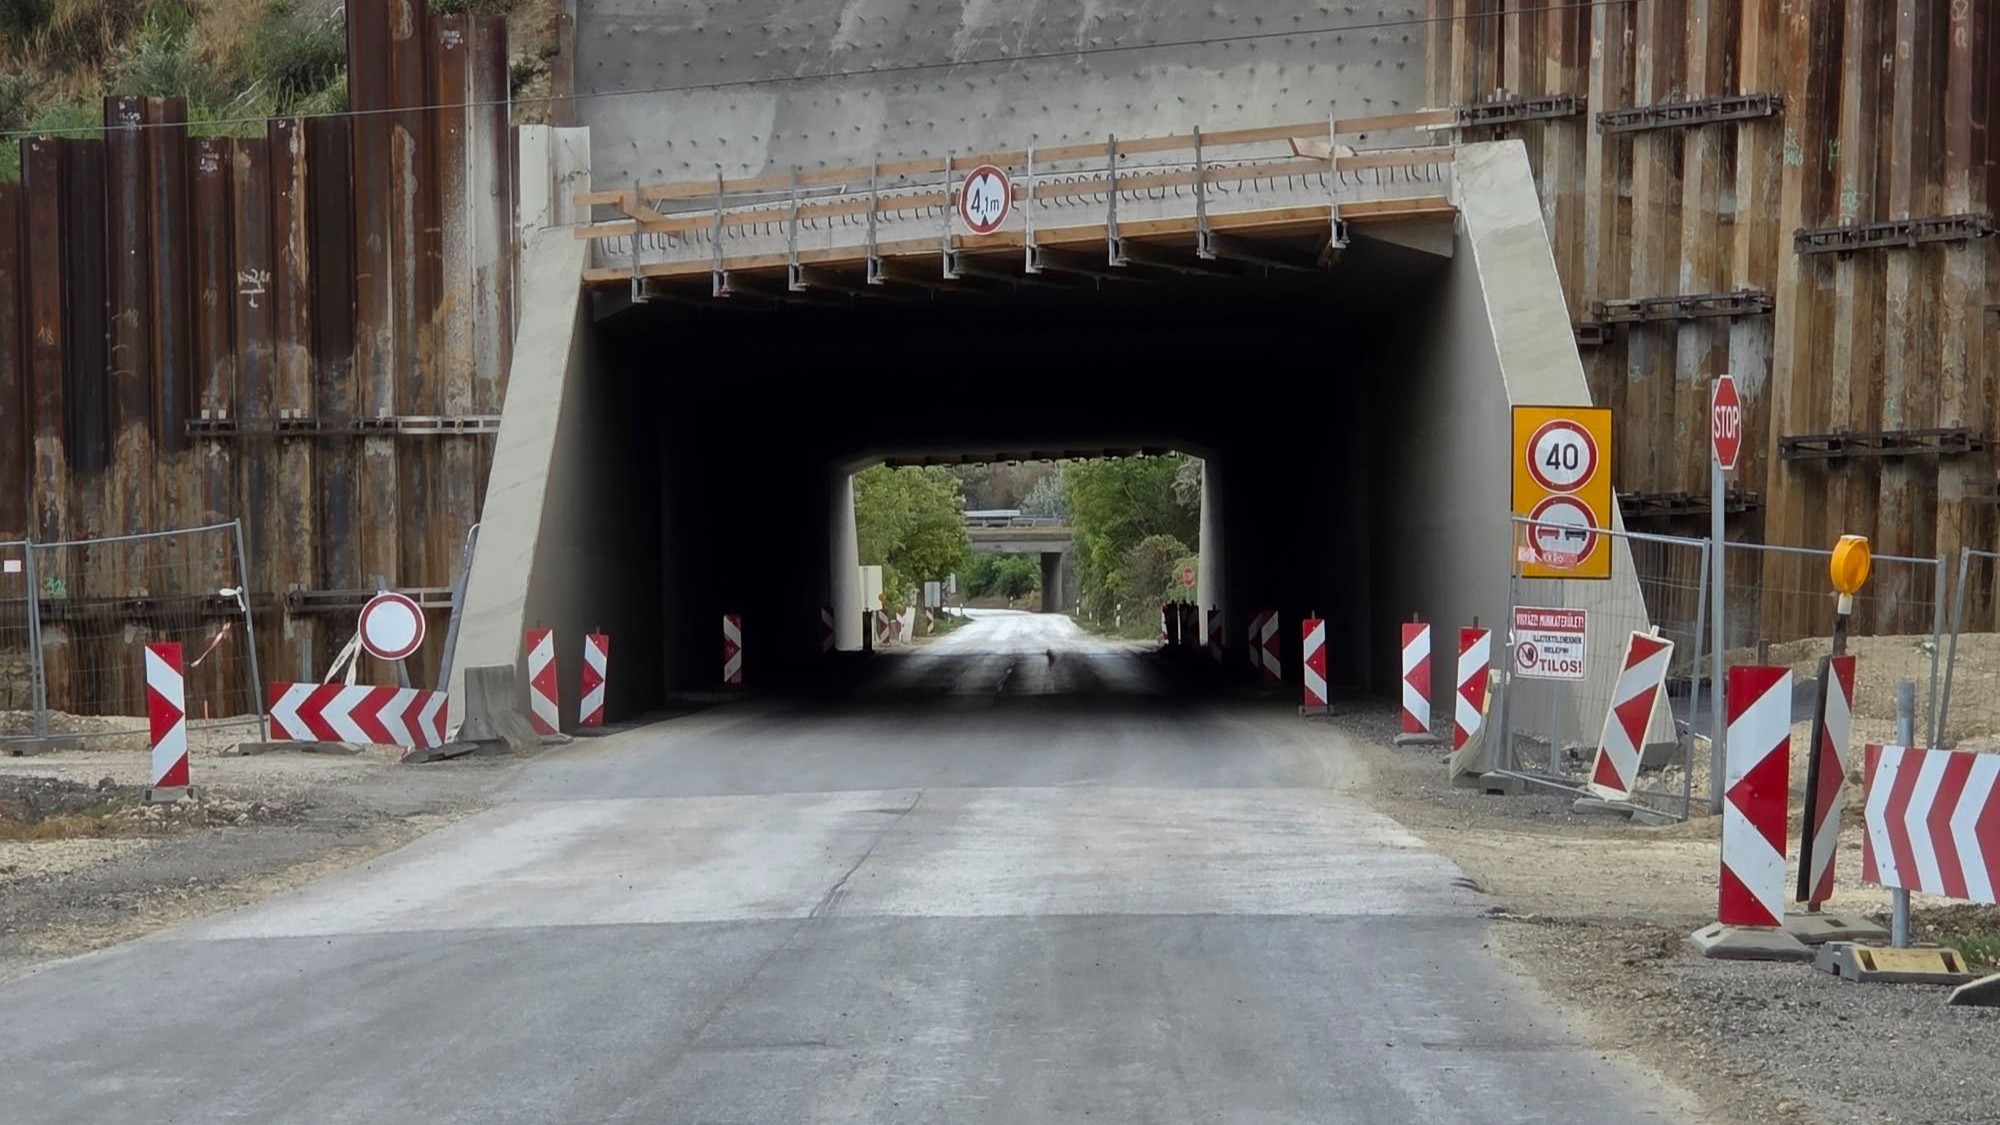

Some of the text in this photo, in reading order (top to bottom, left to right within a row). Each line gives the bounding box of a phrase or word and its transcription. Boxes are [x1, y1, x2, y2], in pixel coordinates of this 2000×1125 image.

[970, 187, 1000, 215] 4,1m
[1714, 404, 1740, 439] STOP
[1545, 442, 1579, 471] 40
[1538, 658, 1583, 674] TILOS!
